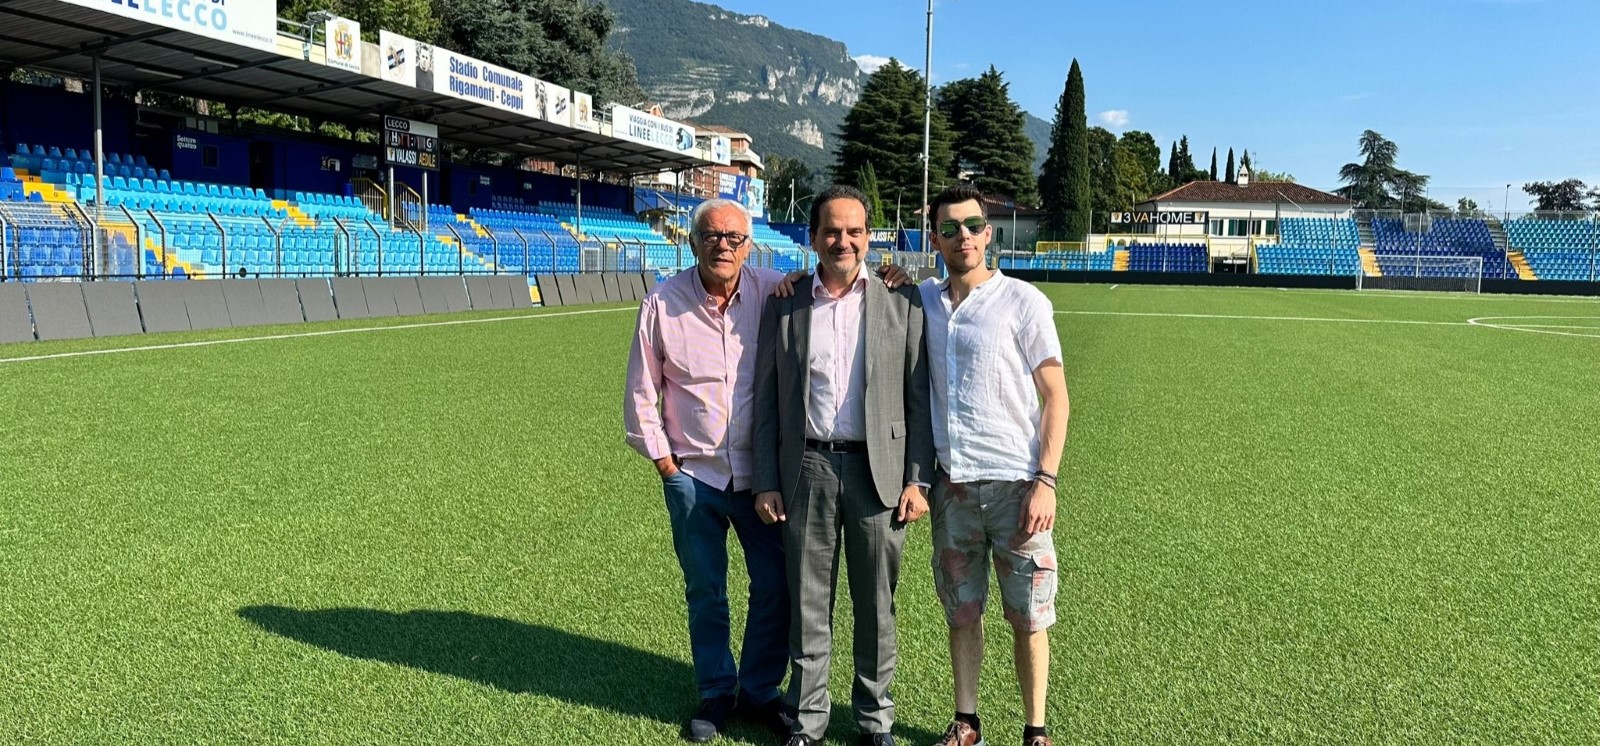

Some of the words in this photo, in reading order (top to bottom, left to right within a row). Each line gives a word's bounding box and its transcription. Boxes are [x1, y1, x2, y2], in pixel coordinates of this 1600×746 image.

[449, 56, 478, 80] Stadio
[482, 66, 523, 92] Comunale
[449, 75, 495, 103] Rigamonti
[500, 90, 524, 110] Ceppi
[388, 119, 408, 130] LECCO
[629, 114, 646, 126] VIAGGIA
[647, 119, 657, 129] CON
[660, 123, 668, 132] BUS
[176, 134, 196, 143] Settore
[176, 142, 197, 150] quattro
[392, 132, 398, 142] H
[426, 138, 432, 149] G
[396, 148, 416, 165] VALASSI
[418, 152, 436, 168] AEDILE
